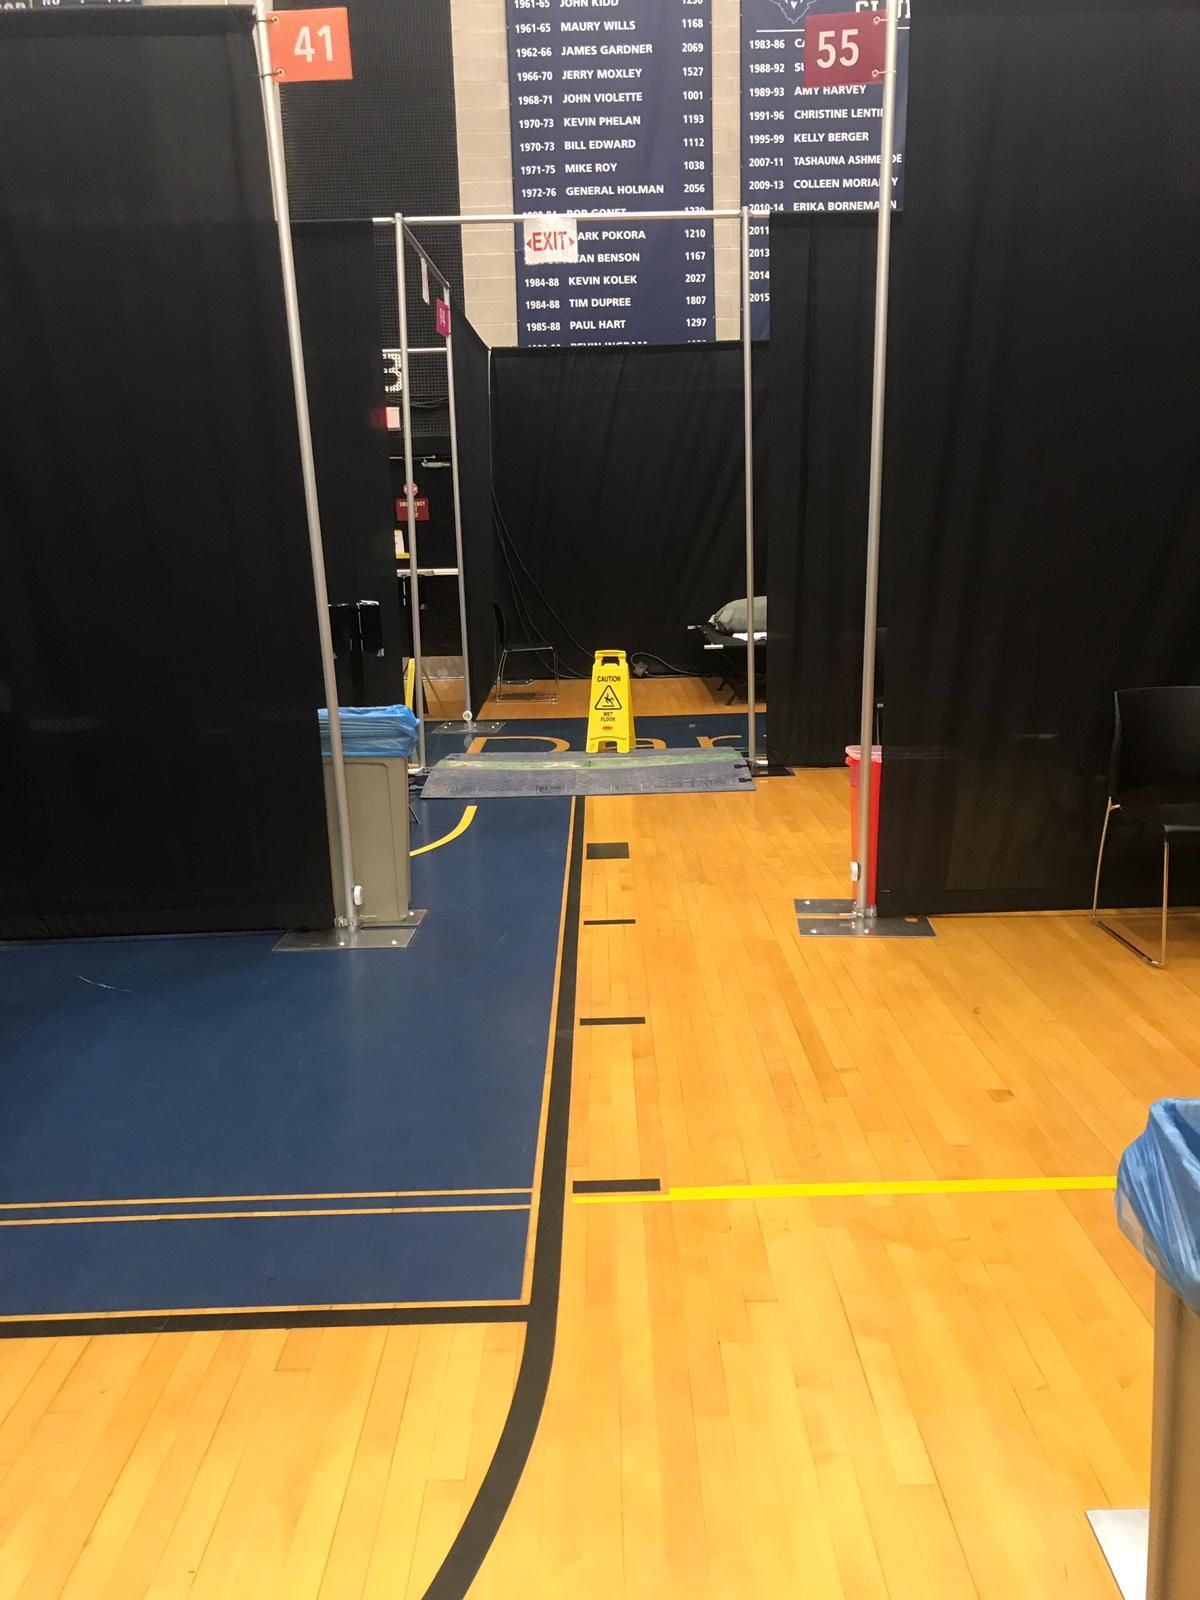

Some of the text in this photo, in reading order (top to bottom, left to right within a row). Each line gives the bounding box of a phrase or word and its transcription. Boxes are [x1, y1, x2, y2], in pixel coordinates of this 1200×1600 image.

[515, 18, 704, 34] 1961-65 MAURY WILLS 1168
[294, 24, 333, 63] 41
[516, 42, 704, 58] 1962-66 JAMES GARDNER 2069
[749, 39, 786, 50] 1983-86
[816, 28, 859, 69] 55
[517, 66, 704, 82] 1966-70 JERRY MOXLEY 1527
[749, 63, 785, 74] 1988-92
[518, 90, 703, 106] 1968-71 JOHN VIOLETTE 1001
[749, 84, 867, 97] 1989-93 AMY HARVEY
[519, 114, 705, 129] 1970-73 KEVIN PHELAN 1193
[749, 110, 785, 121] 1991-96
[793, 108, 849, 120] CHRISTINE
[519, 137, 705, 152] 1970-73 BILL EDWARD 1112
[749, 131, 869, 144] 1995-99 KELLY BERGER
[520, 160, 705, 175] 1971-75 MIKE ROY 1038
[748, 153, 903, 167] 2007-11 TASHAUNA ASHMEDE
[521, 183, 706, 198] 1972-76 GENERAL HOLMAN 2056
[748, 176, 899, 190] 2009-13 COLLEEN MORIAY
[793, 201, 825, 212] ERIKA
[827, 199, 897, 211] BORNEMAN
[532, 231, 567, 252] EXIT
[576, 228, 706, 241] ARK POKORA 1210
[576, 251, 706, 264] TAN BENSON 1167
[524, 273, 706, 288] 1984-88 KEVIN KOLEK 2027
[525, 295, 707, 310] 1984-88 TIM DUPREE 1807
[526, 317, 707, 332] 1985-88 PAUL HART 1297
[596, 675, 622, 683] CAUTION
